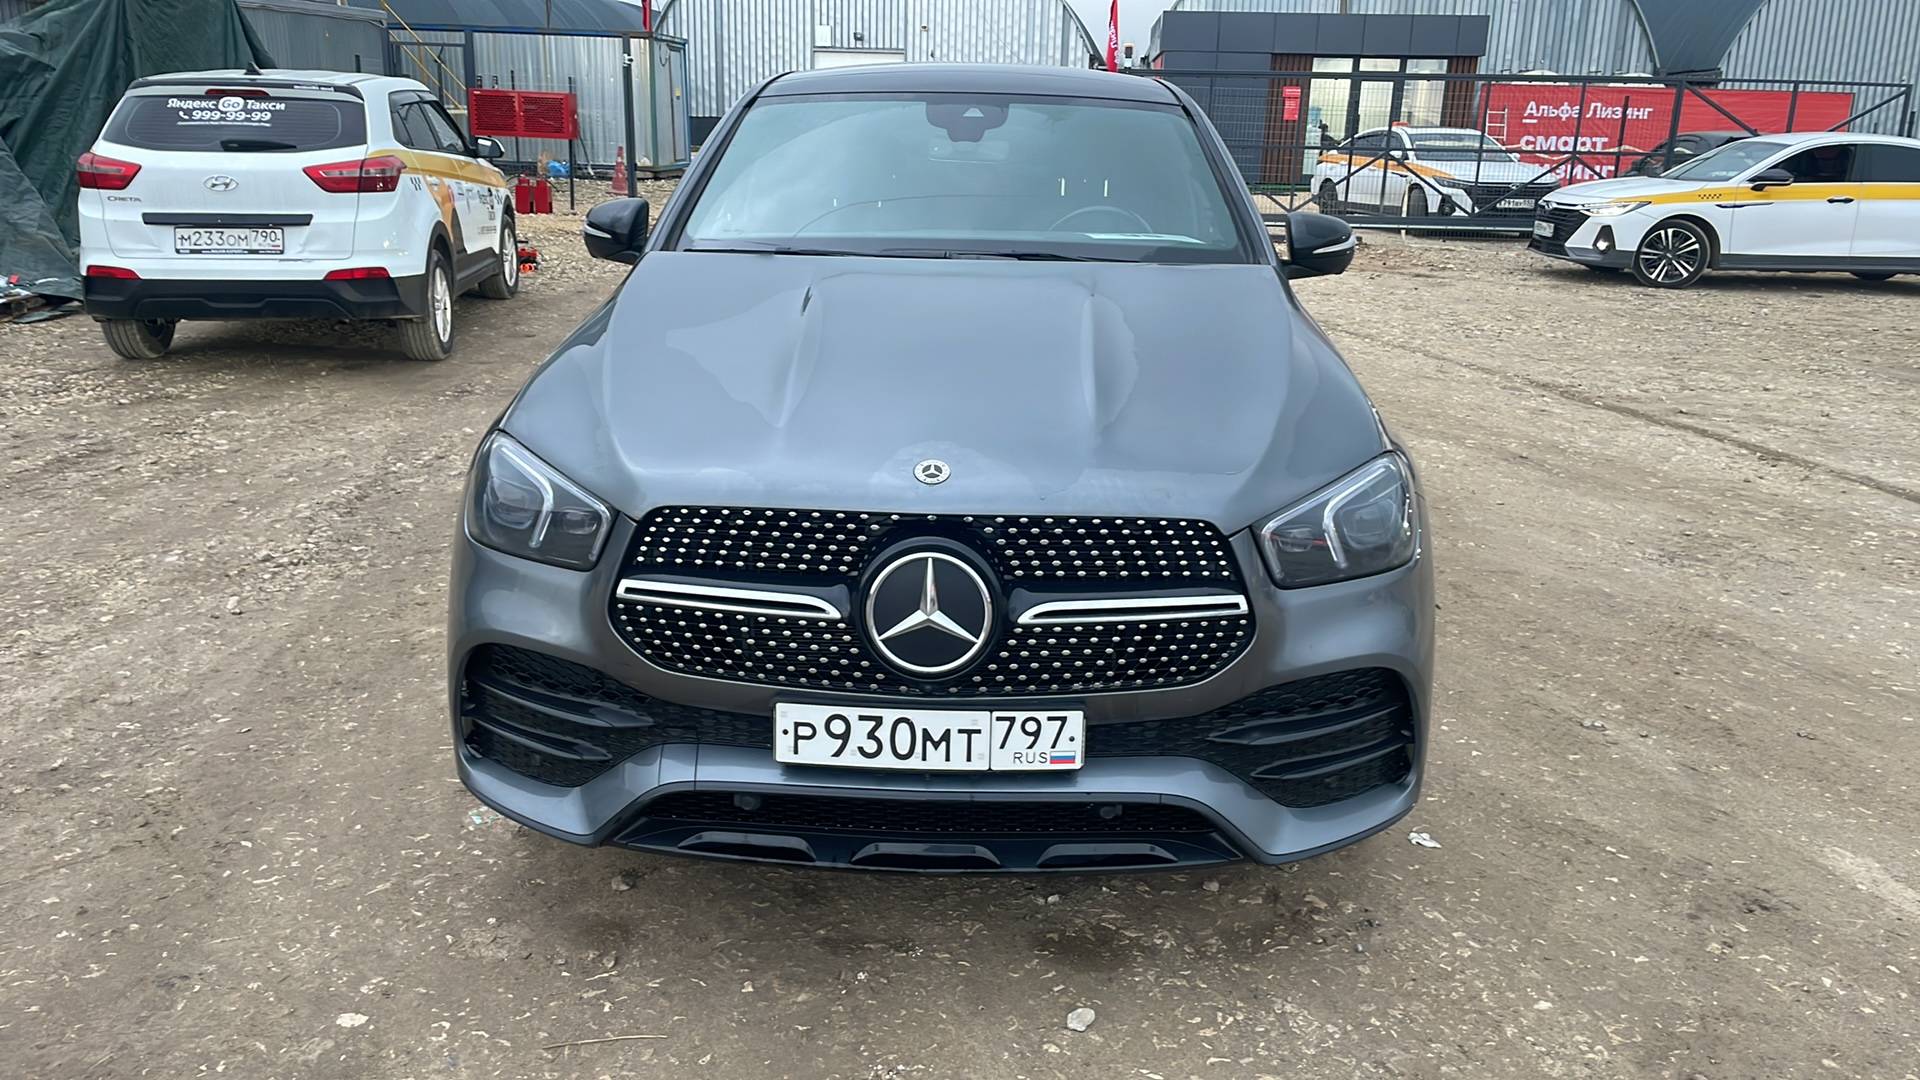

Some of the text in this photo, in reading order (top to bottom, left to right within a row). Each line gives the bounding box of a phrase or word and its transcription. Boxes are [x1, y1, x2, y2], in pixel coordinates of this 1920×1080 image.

[166, 98, 218, 110] Яндекс
[246, 100, 286, 111] Такси
[1523, 101, 1580, 122] Альфа
[191, 110, 272, 121] 999-99-99
[180, 229, 277, 247] М233ОМ 790
[793, 713, 1068, 762] Р930МТ 797
[1013, 751, 1048, 765] RUS
